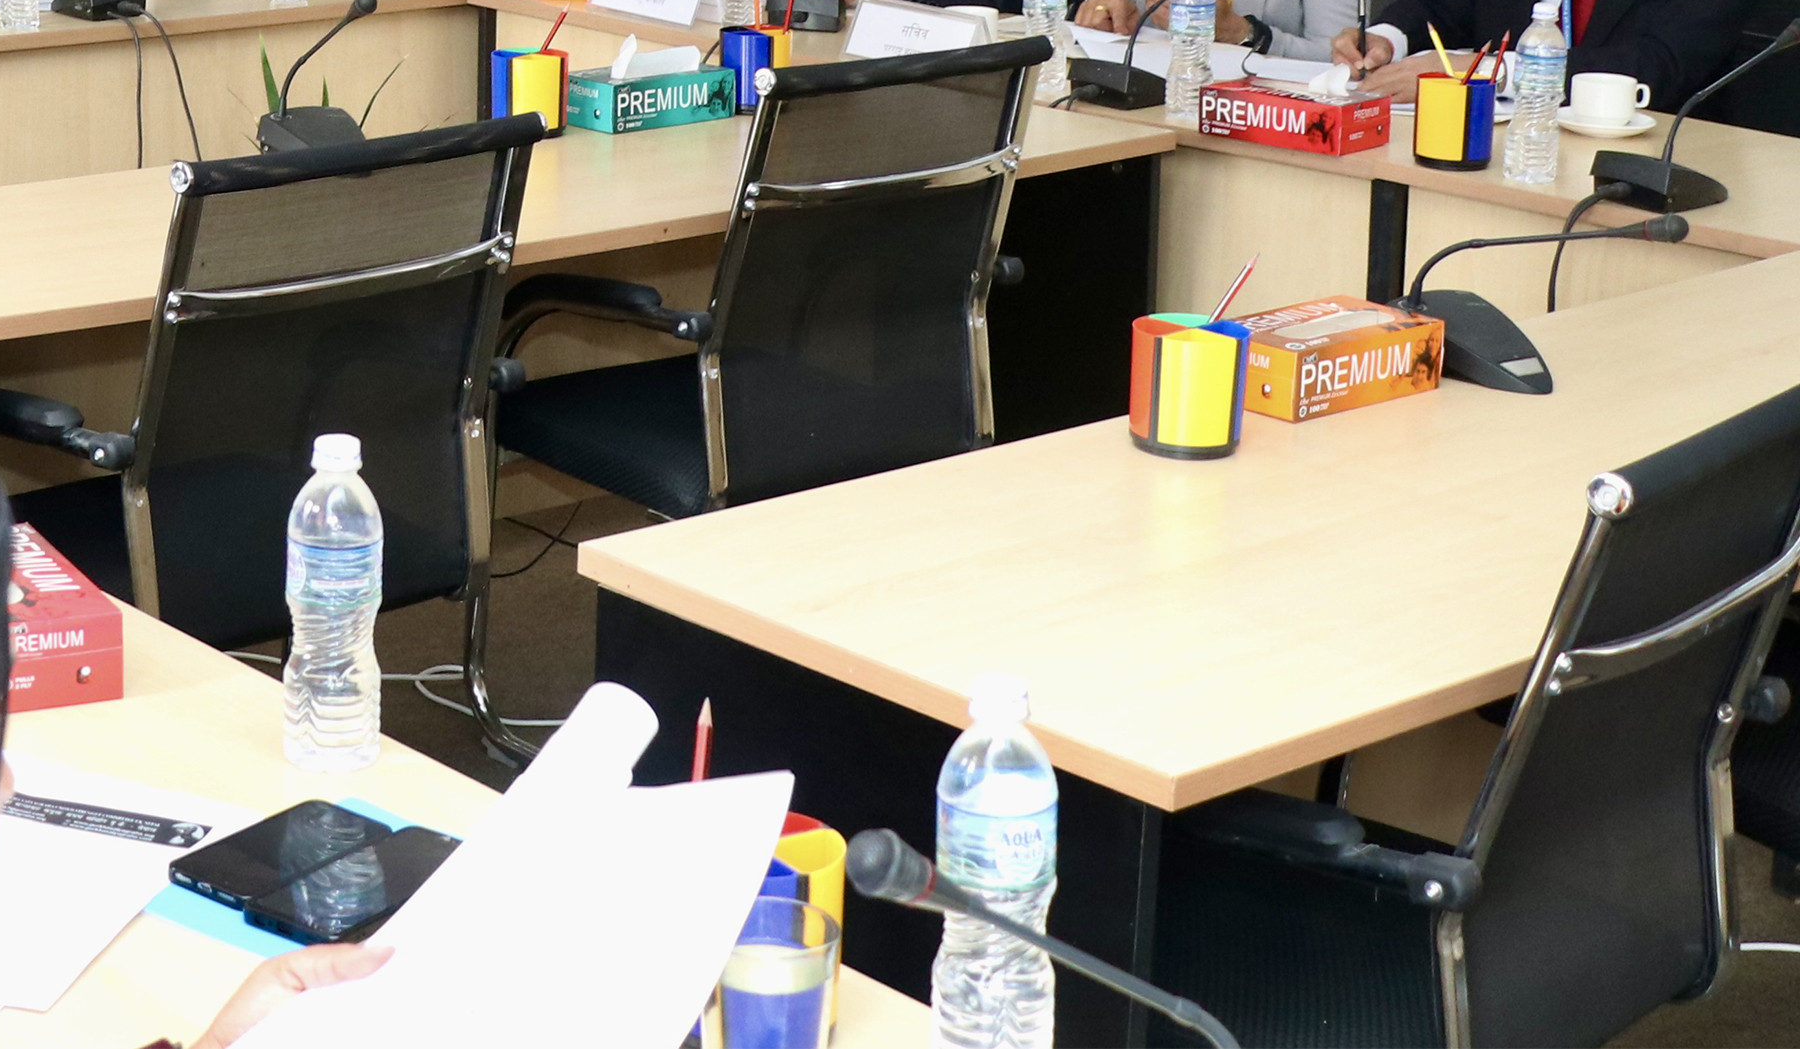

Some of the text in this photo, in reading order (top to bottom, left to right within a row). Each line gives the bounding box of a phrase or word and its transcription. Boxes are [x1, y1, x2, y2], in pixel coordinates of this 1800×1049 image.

[617, 82, 708, 117] PREMIUM
[1201, 95, 1306, 135] PREMIUM
[1353, 106, 1380, 120] PREMIUM
[1300, 341, 1412, 398] PREMIUM
[11, 528, 81, 592] REMIUM
[15, 629, 85, 652] REMIUM
